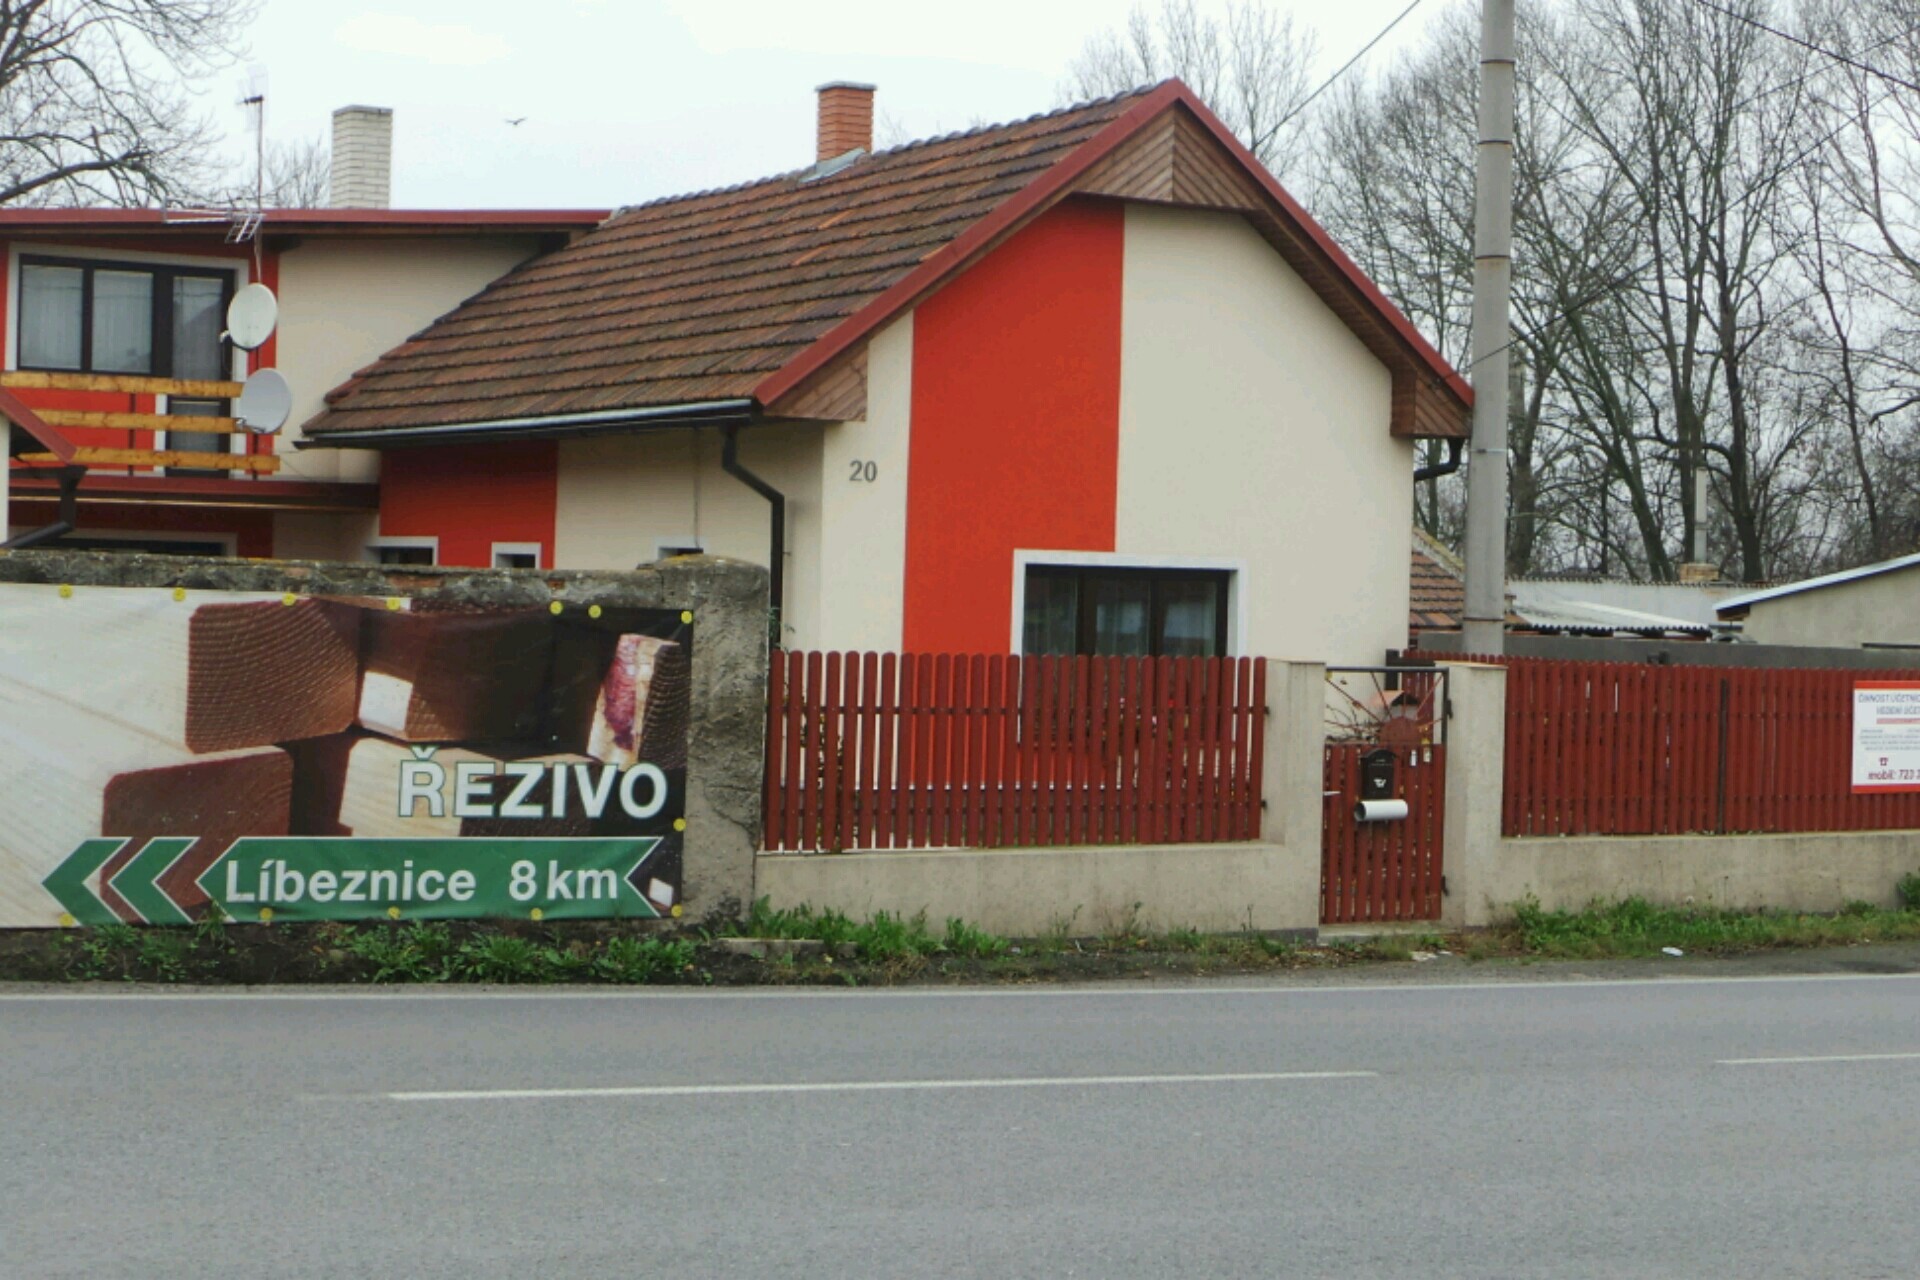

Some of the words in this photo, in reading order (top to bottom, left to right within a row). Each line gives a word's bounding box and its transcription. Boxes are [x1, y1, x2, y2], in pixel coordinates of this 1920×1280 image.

[849, 459, 878, 483] 20
[398, 745, 668, 819] ŘEZIVO
[225, 860, 477, 903] Líbeznice
[508, 860, 538, 901] 8
[546, 860, 618, 900] km
